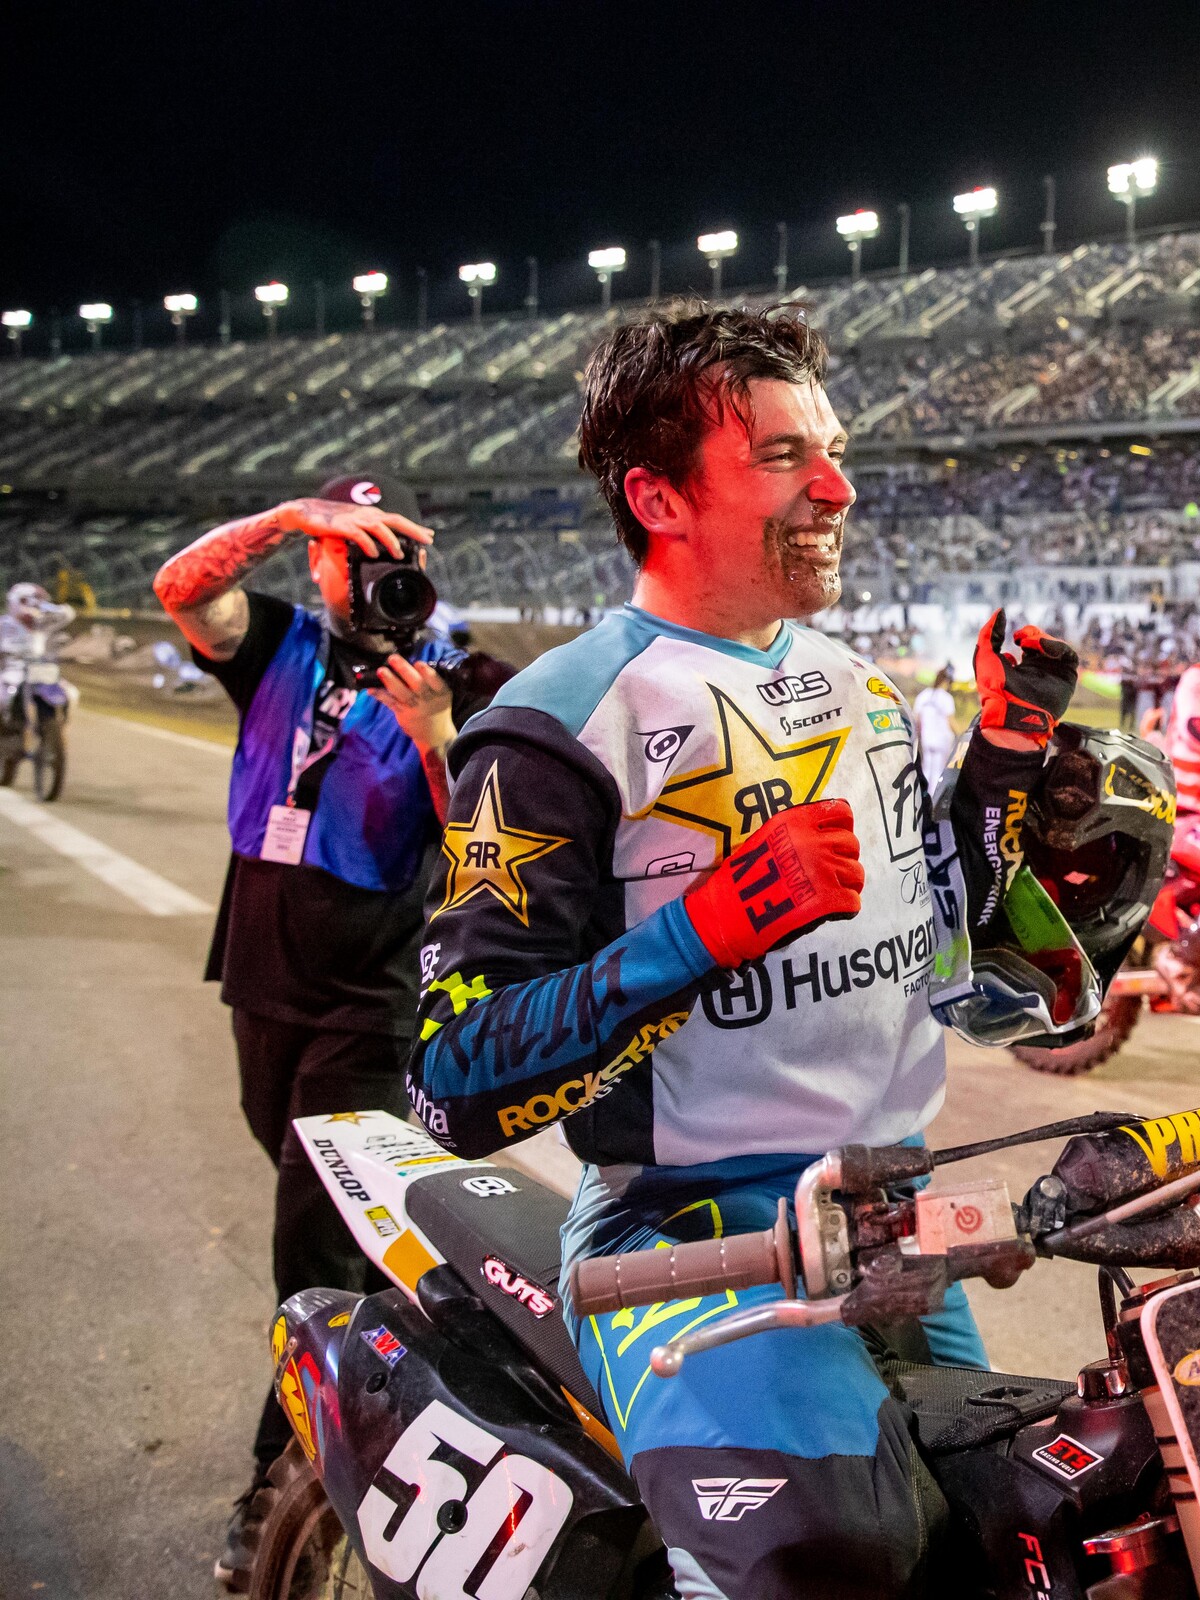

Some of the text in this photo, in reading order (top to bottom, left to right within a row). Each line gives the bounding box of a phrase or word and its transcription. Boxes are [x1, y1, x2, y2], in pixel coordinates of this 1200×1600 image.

[756, 671, 832, 707] WPS
[792, 707, 843, 729] SCOTT
[729, 841, 797, 936] FLY
[313, 1138, 371, 1202] DUNLOP
[483, 1259, 555, 1314] GUTS
[1047, 1440, 1095, 1470] ETS
[357, 1399, 574, 1600] 50
